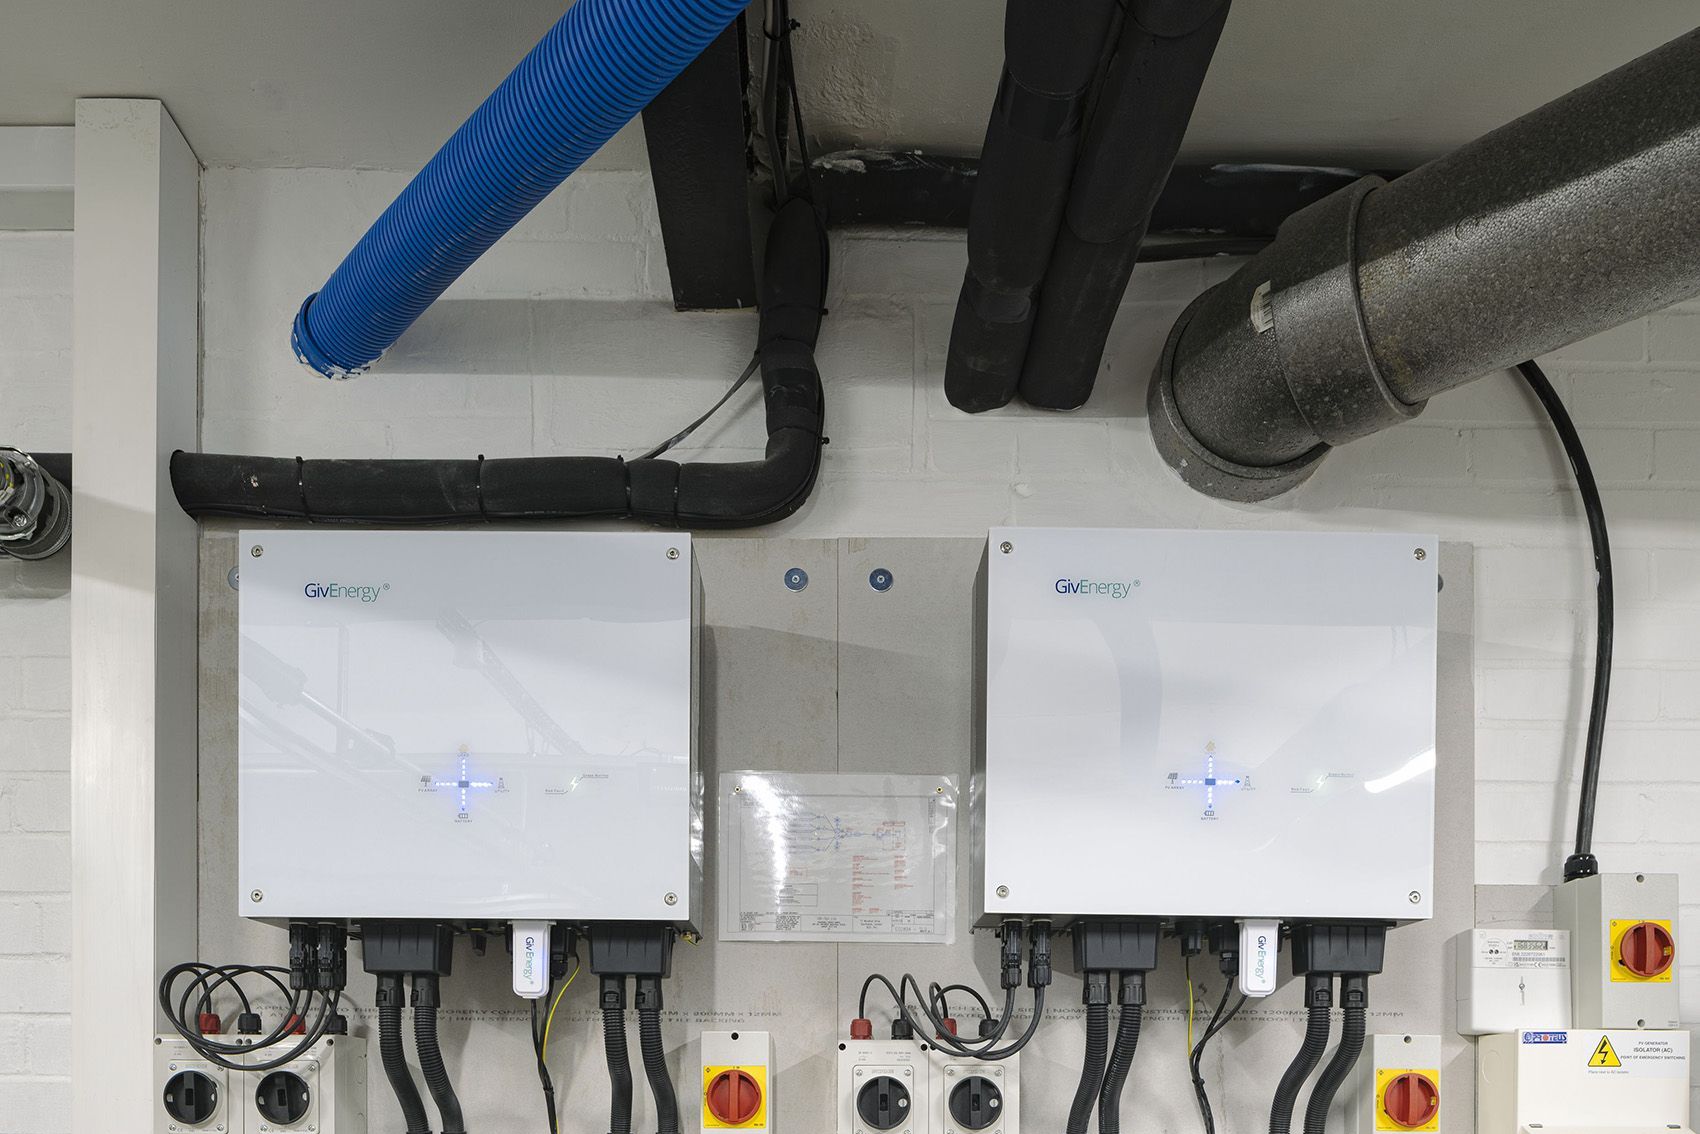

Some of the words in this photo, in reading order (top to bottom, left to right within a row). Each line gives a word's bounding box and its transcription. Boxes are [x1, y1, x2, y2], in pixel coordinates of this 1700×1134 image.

[304, 583, 381, 602] GivEnergy
[1055, 579, 1131, 599] GivEnergy
[524, 937, 534, 980] GivEnergy
[1255, 936, 1266, 979] GivEnergy
